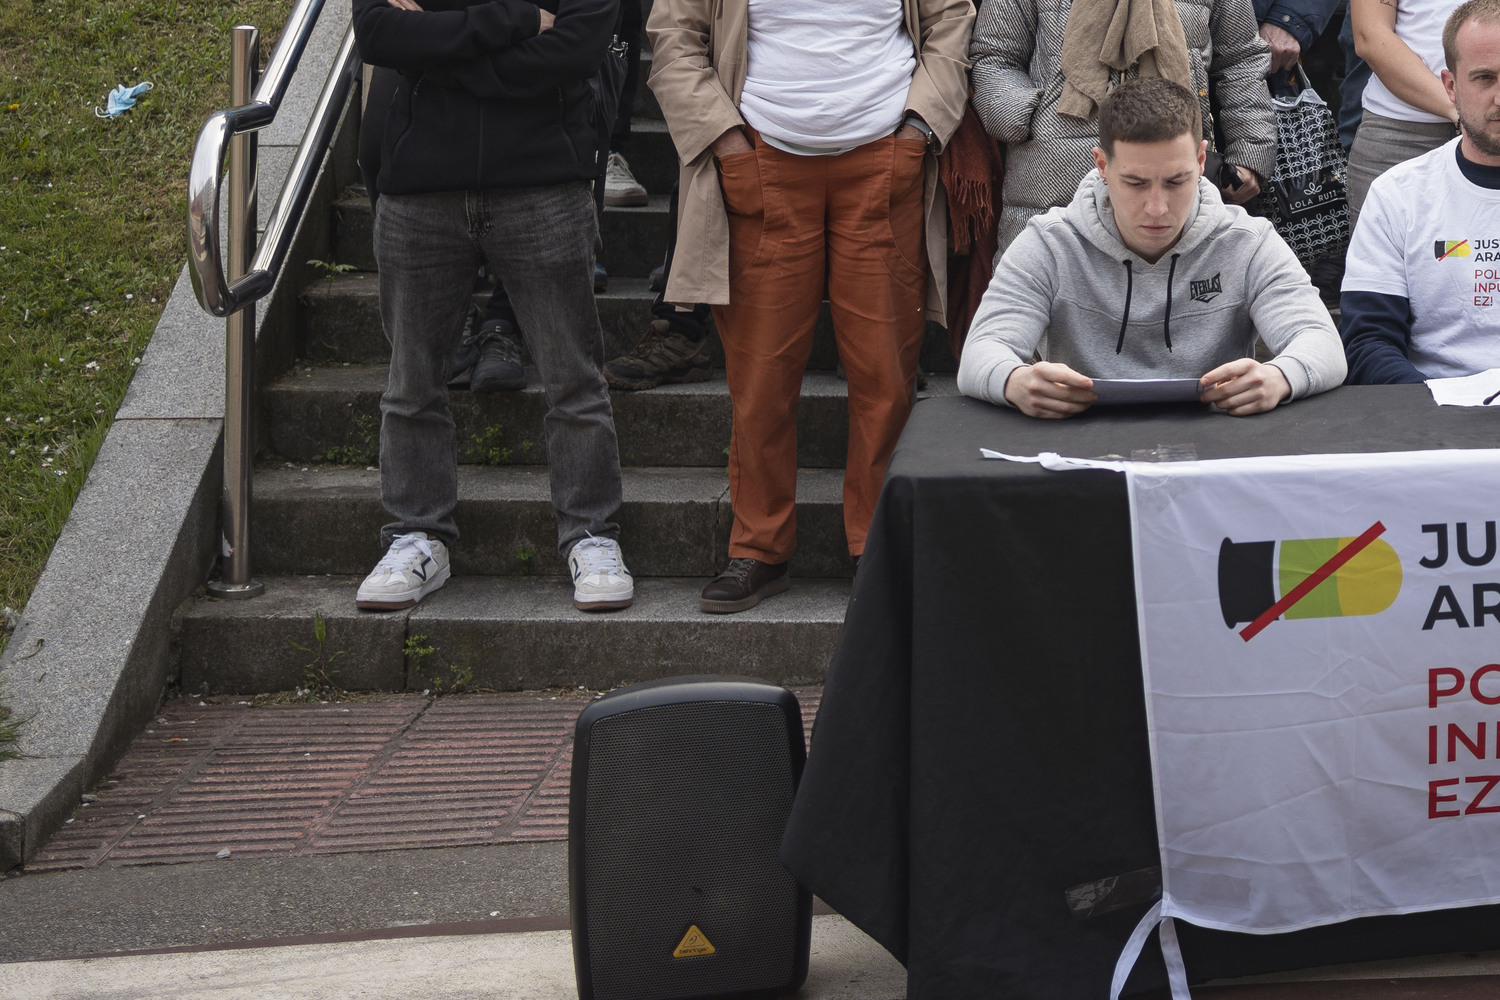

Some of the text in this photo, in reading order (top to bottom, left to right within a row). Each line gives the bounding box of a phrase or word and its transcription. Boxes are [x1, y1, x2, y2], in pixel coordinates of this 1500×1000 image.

[1289, 198, 1314, 211] LOLA
[1189, 271, 1223, 300] EVERLAST
[1474, 296, 1494, 307] EZ!
